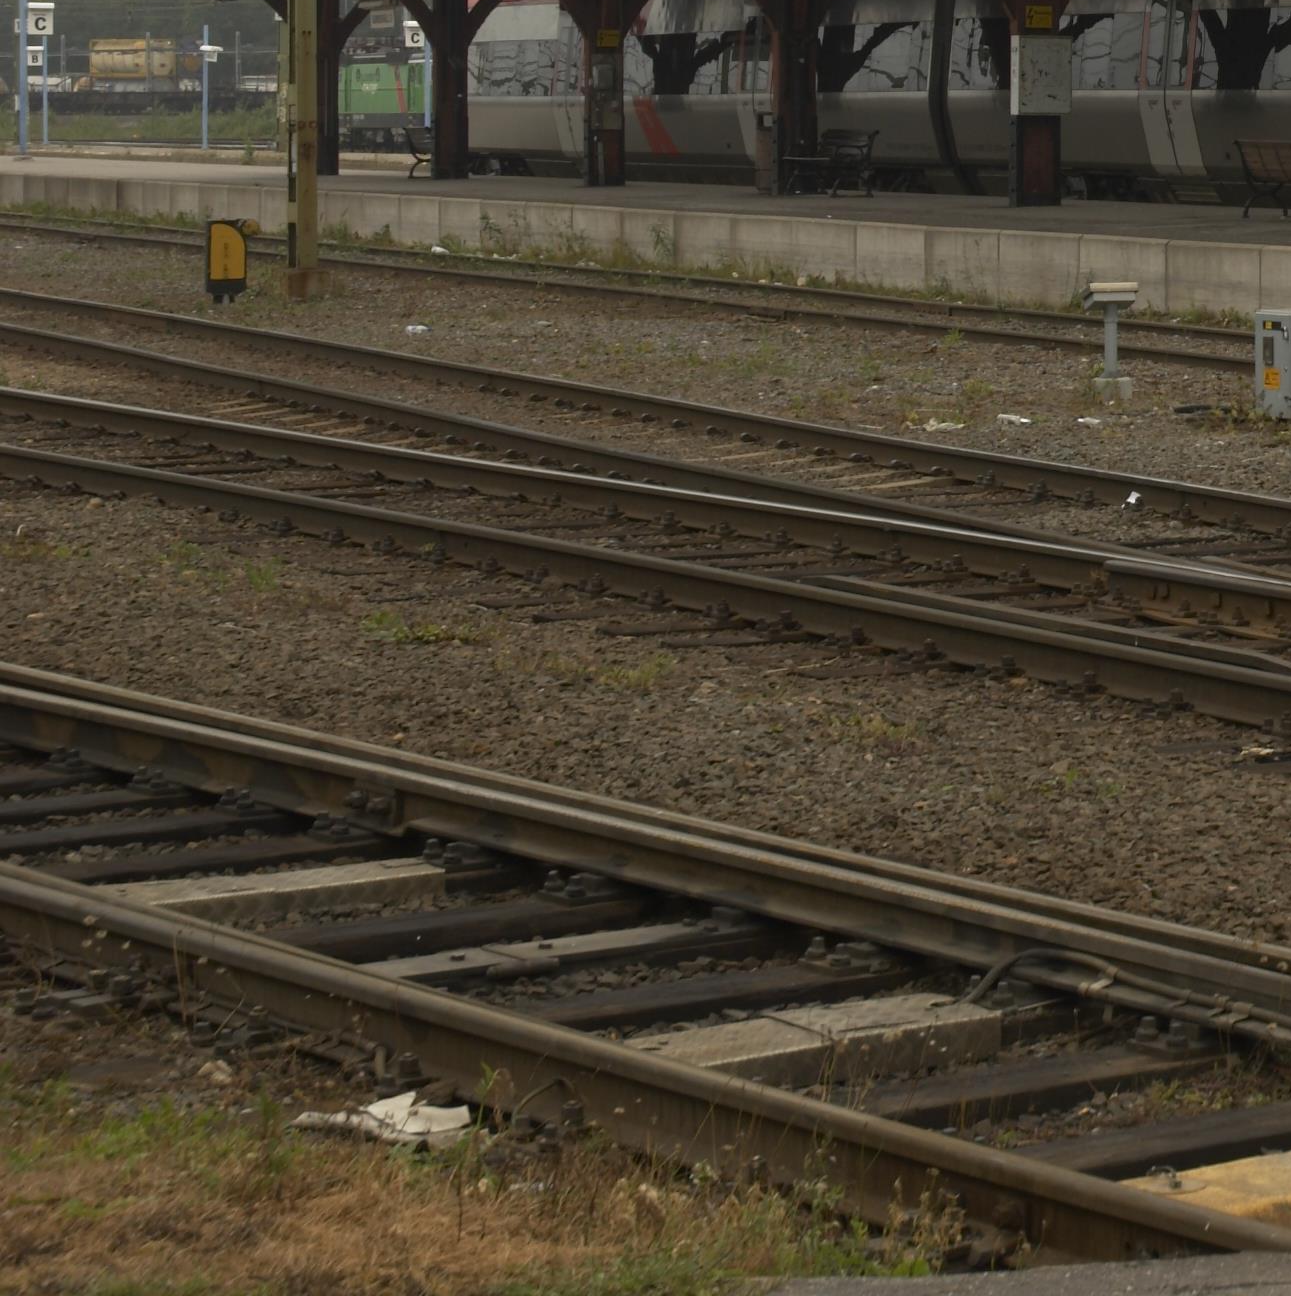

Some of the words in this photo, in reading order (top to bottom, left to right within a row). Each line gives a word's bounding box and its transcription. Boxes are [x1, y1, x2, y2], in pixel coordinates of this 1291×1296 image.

[34, 16, 47, 31] C
[411, 32, 420, 44] C
[31, 54, 39, 64] B
